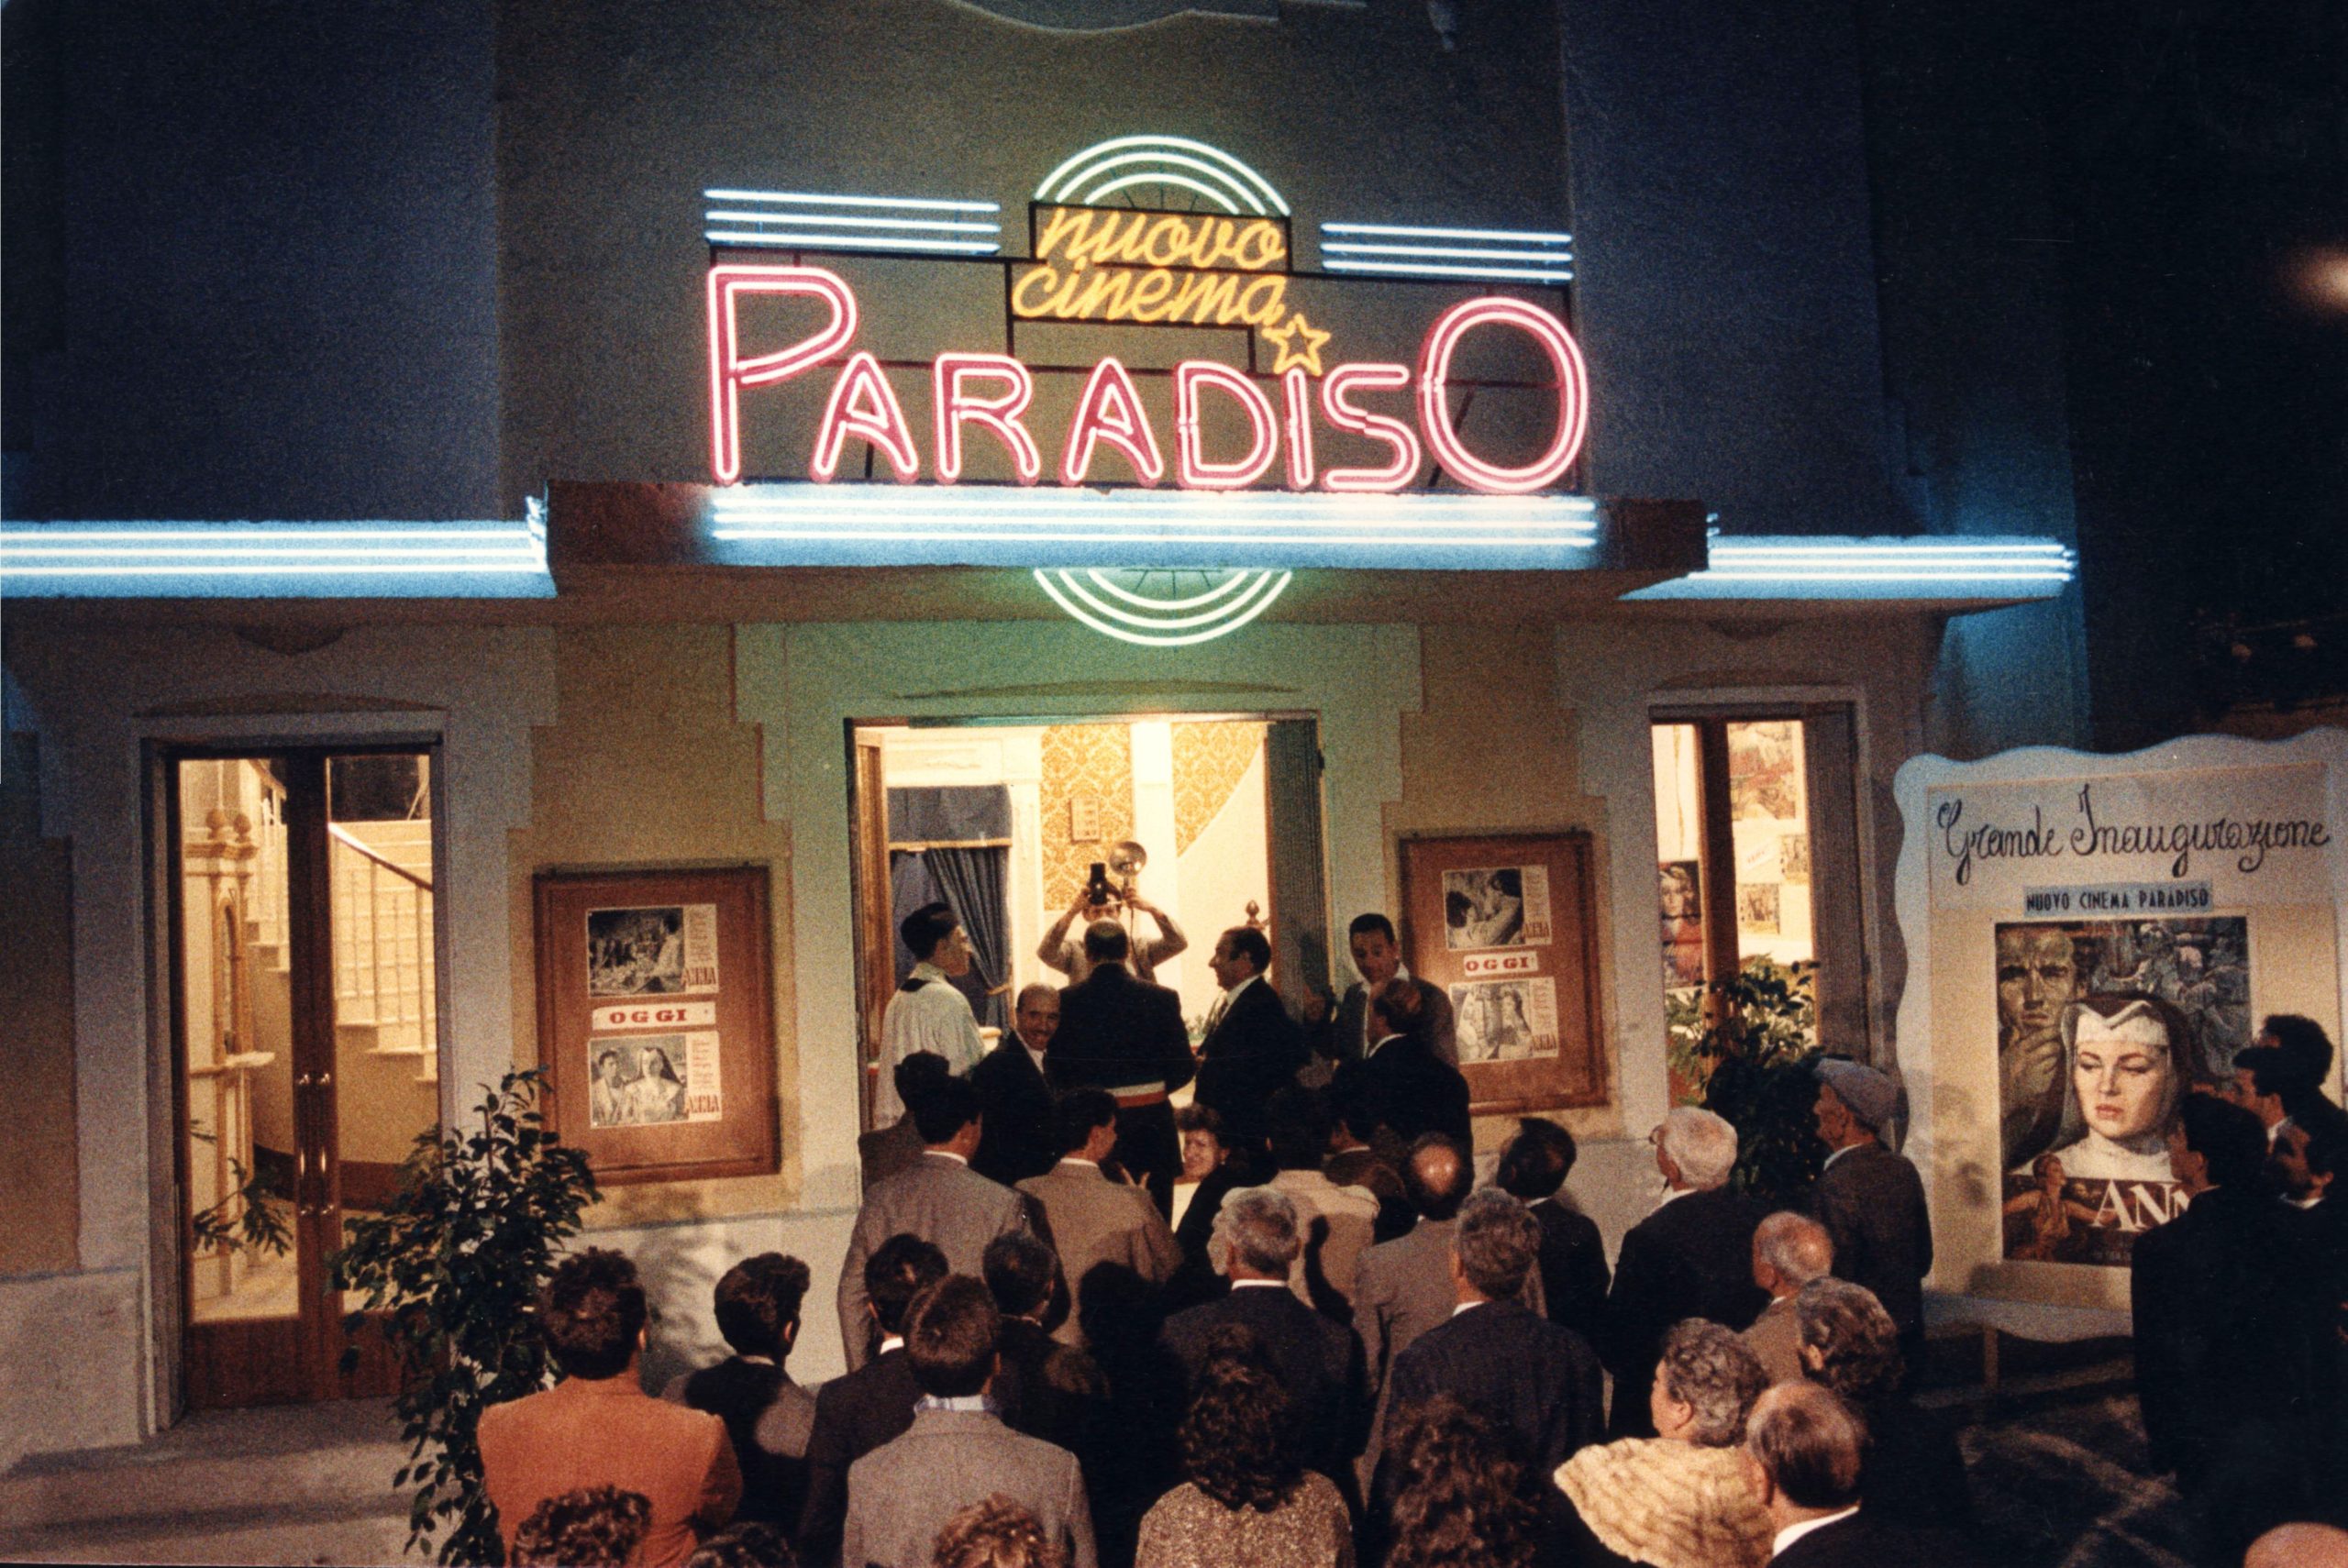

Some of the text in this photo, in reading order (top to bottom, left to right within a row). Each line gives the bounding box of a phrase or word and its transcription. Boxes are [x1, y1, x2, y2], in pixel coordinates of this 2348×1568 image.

[1036, 207, 1287, 271] nuovo
[1011, 255, 1288, 326] cinema
[1937, 783, 2331, 886] Grande Inaugurazione
[2025, 888, 2210, 911] NUOVO CINEMA PARADISO
[1465, 956, 1529, 972] OGGI
[608, 1008, 687, 1025] OGGI
